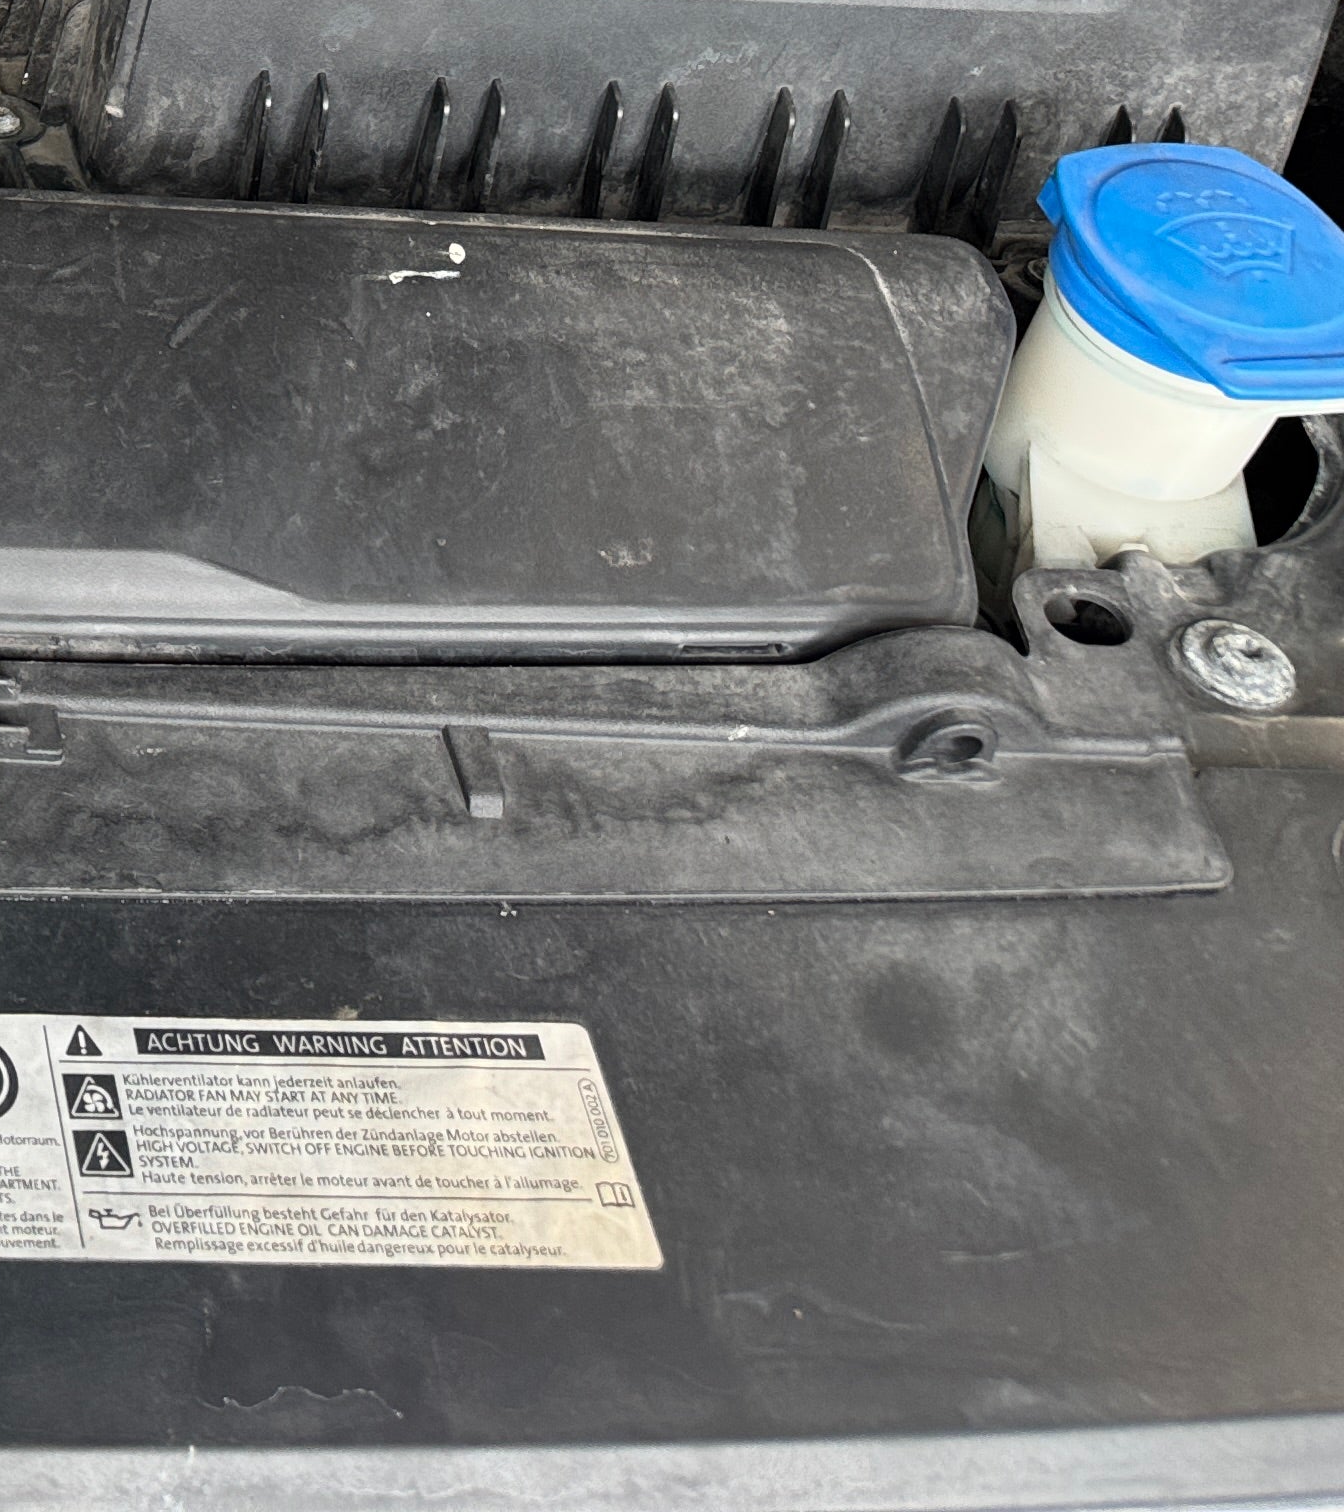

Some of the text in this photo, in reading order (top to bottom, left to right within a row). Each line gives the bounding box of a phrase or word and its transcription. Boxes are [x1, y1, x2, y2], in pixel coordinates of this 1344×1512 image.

[147, 1032, 527, 1057] ACHTUNG WARNING ATTENTION
[122, 1073, 402, 1091] Kühlerventilator kann jederzeit anlaufen.
[125, 1088, 401, 1105] RADIATOR FAN MAY START AT ANY TIME.
[584, 1094, 601, 1115] 002
[128, 1103, 554, 1123] Le ventilateur de radiateur peut se déclencher à tout moment.
[132, 1124, 558, 1148] Hochspannung, vor Berühren der Zündanlage Motor abstellen.
[592, 1118, 609, 1137] 010
[135, 1139, 597, 1160] HIGH VOLTAGE, SWITCH OFF ENGINE BEFORE TOUCHING IGNITION
[600, 1140, 615, 1158] 701
[138, 1154, 198, 1169] SYSTEM.
[141, 1170, 582, 1193] Haute tension, arrêter le moteur avant de toucher à l'allumage.
[19, 1210, 51, 1223] dans
[52, 1211, 65, 1223] le
[148, 1204, 514, 1227] Bei Überfüllung besteht Gefahr für den Katalysator.
[11, 1224, 61, 1236] moteur.
[151, 1220, 504, 1240] OVERFILLED ENGINE OIL CAN DAMAGE CATALYST.
[154, 1236, 567, 1260] Remplissage excessif d'huile dangereux pour le catalyseur.
